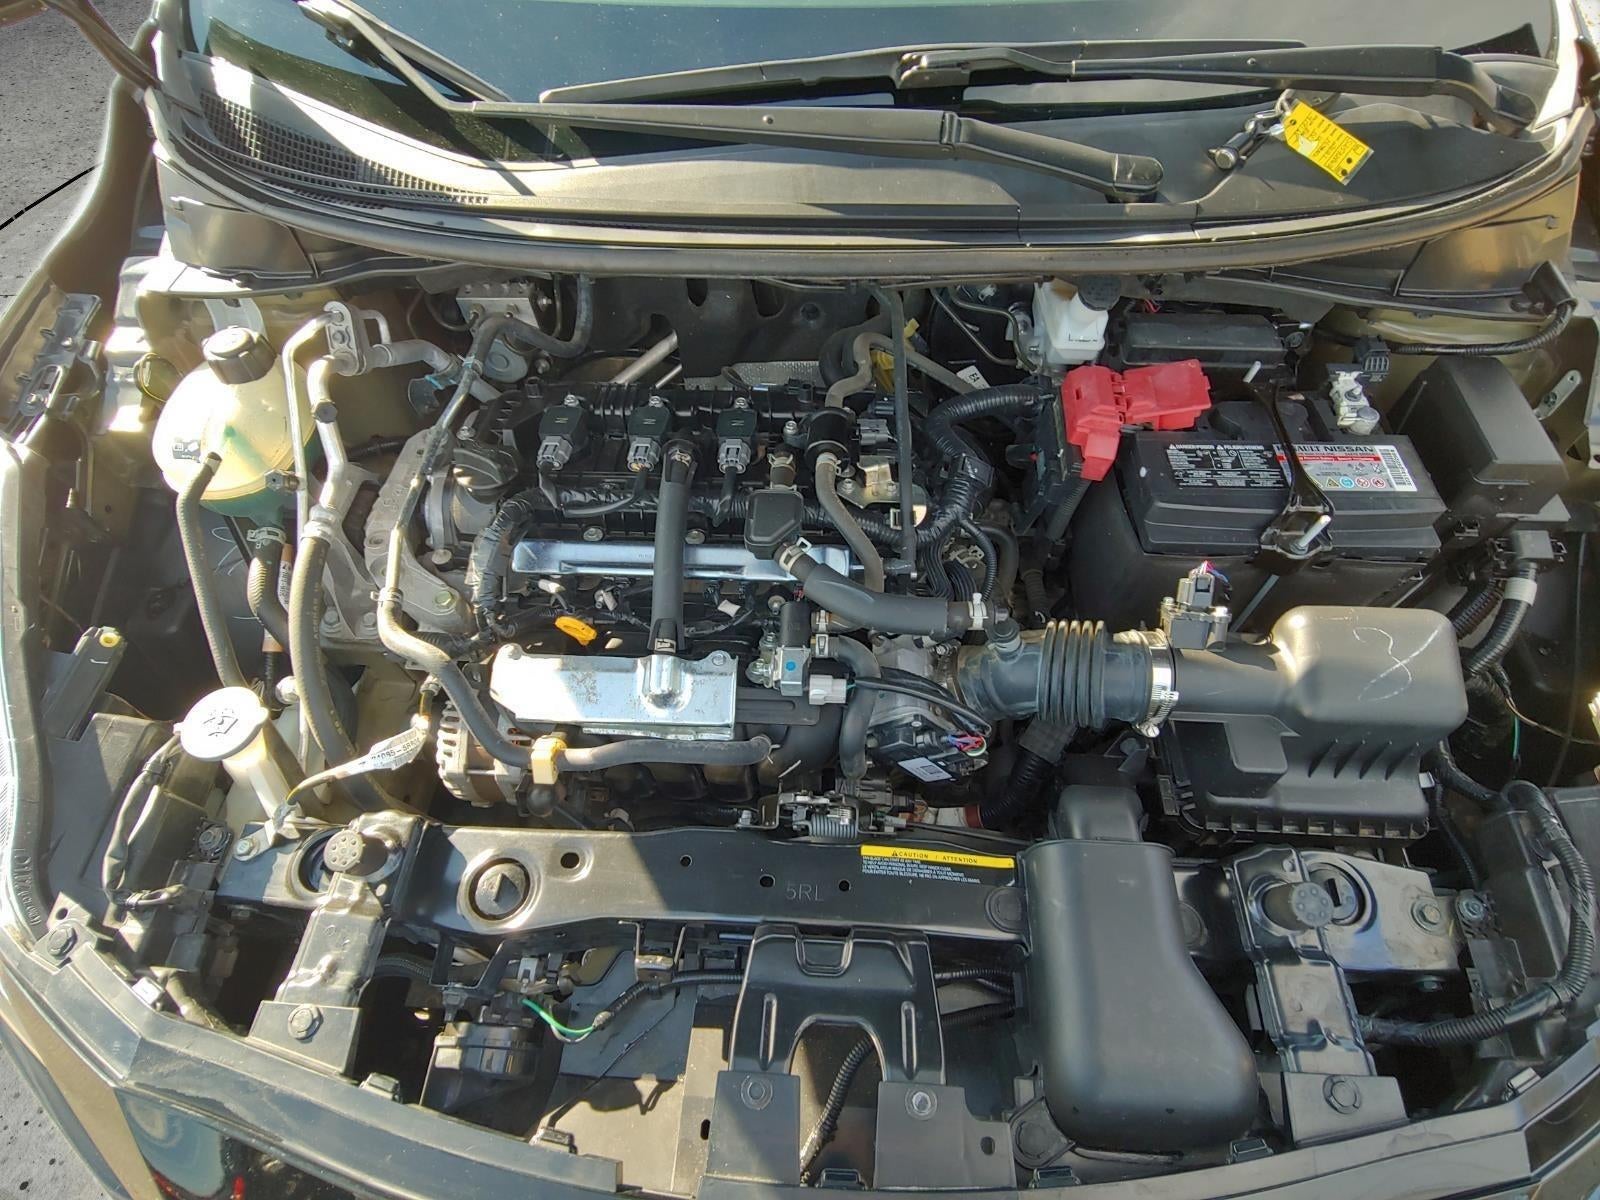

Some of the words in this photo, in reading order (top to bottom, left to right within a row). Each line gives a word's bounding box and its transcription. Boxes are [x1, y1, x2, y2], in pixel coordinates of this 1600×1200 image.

[1324, 445, 1374, 453] NISSAN
[899, 851, 929, 859] CAUTION
[942, 855, 978, 864] ATTENTION
